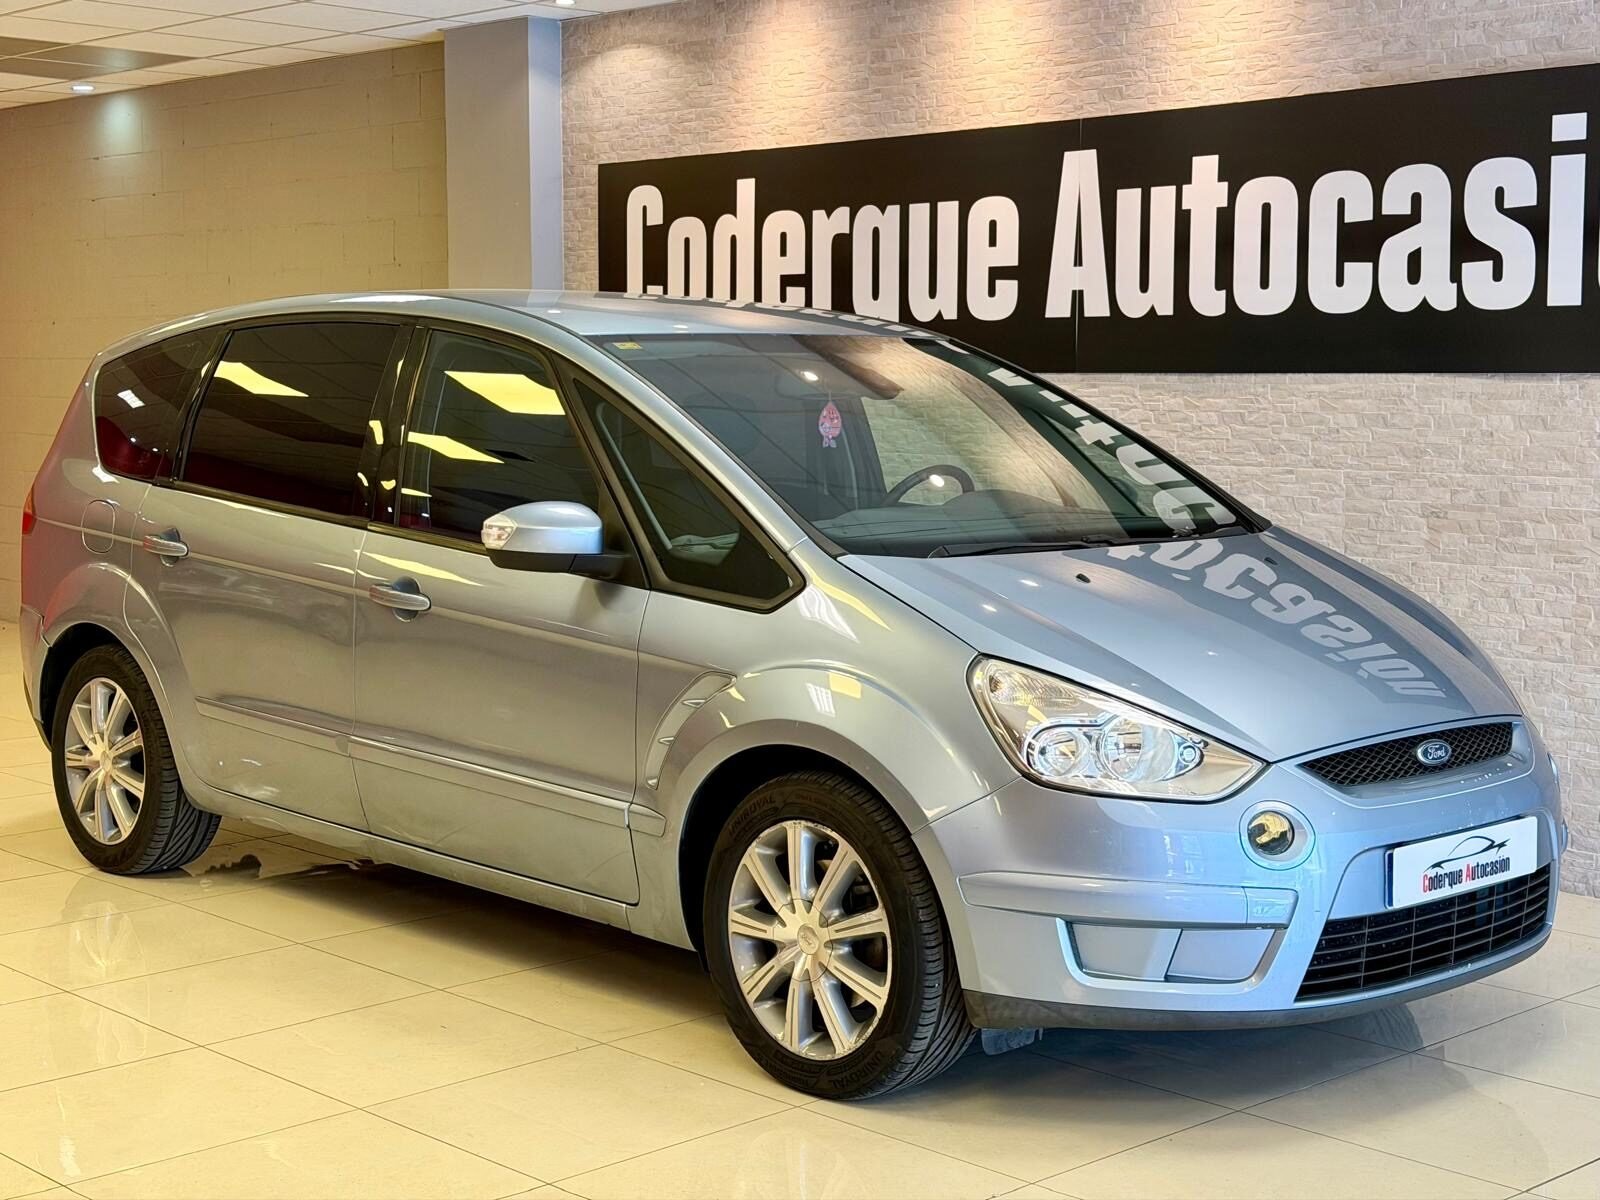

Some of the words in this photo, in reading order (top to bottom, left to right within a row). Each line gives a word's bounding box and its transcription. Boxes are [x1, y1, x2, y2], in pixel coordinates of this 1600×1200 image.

[626, 177, 1019, 323] Coderque
[1045, 112, 1600, 318] Autocasi
[1427, 745, 1446, 760] Ford
[1423, 868, 1463, 893] Coderque
[1465, 855, 1510, 882] Autocasión
[831, 1050, 885, 1090] UNIROYAL
